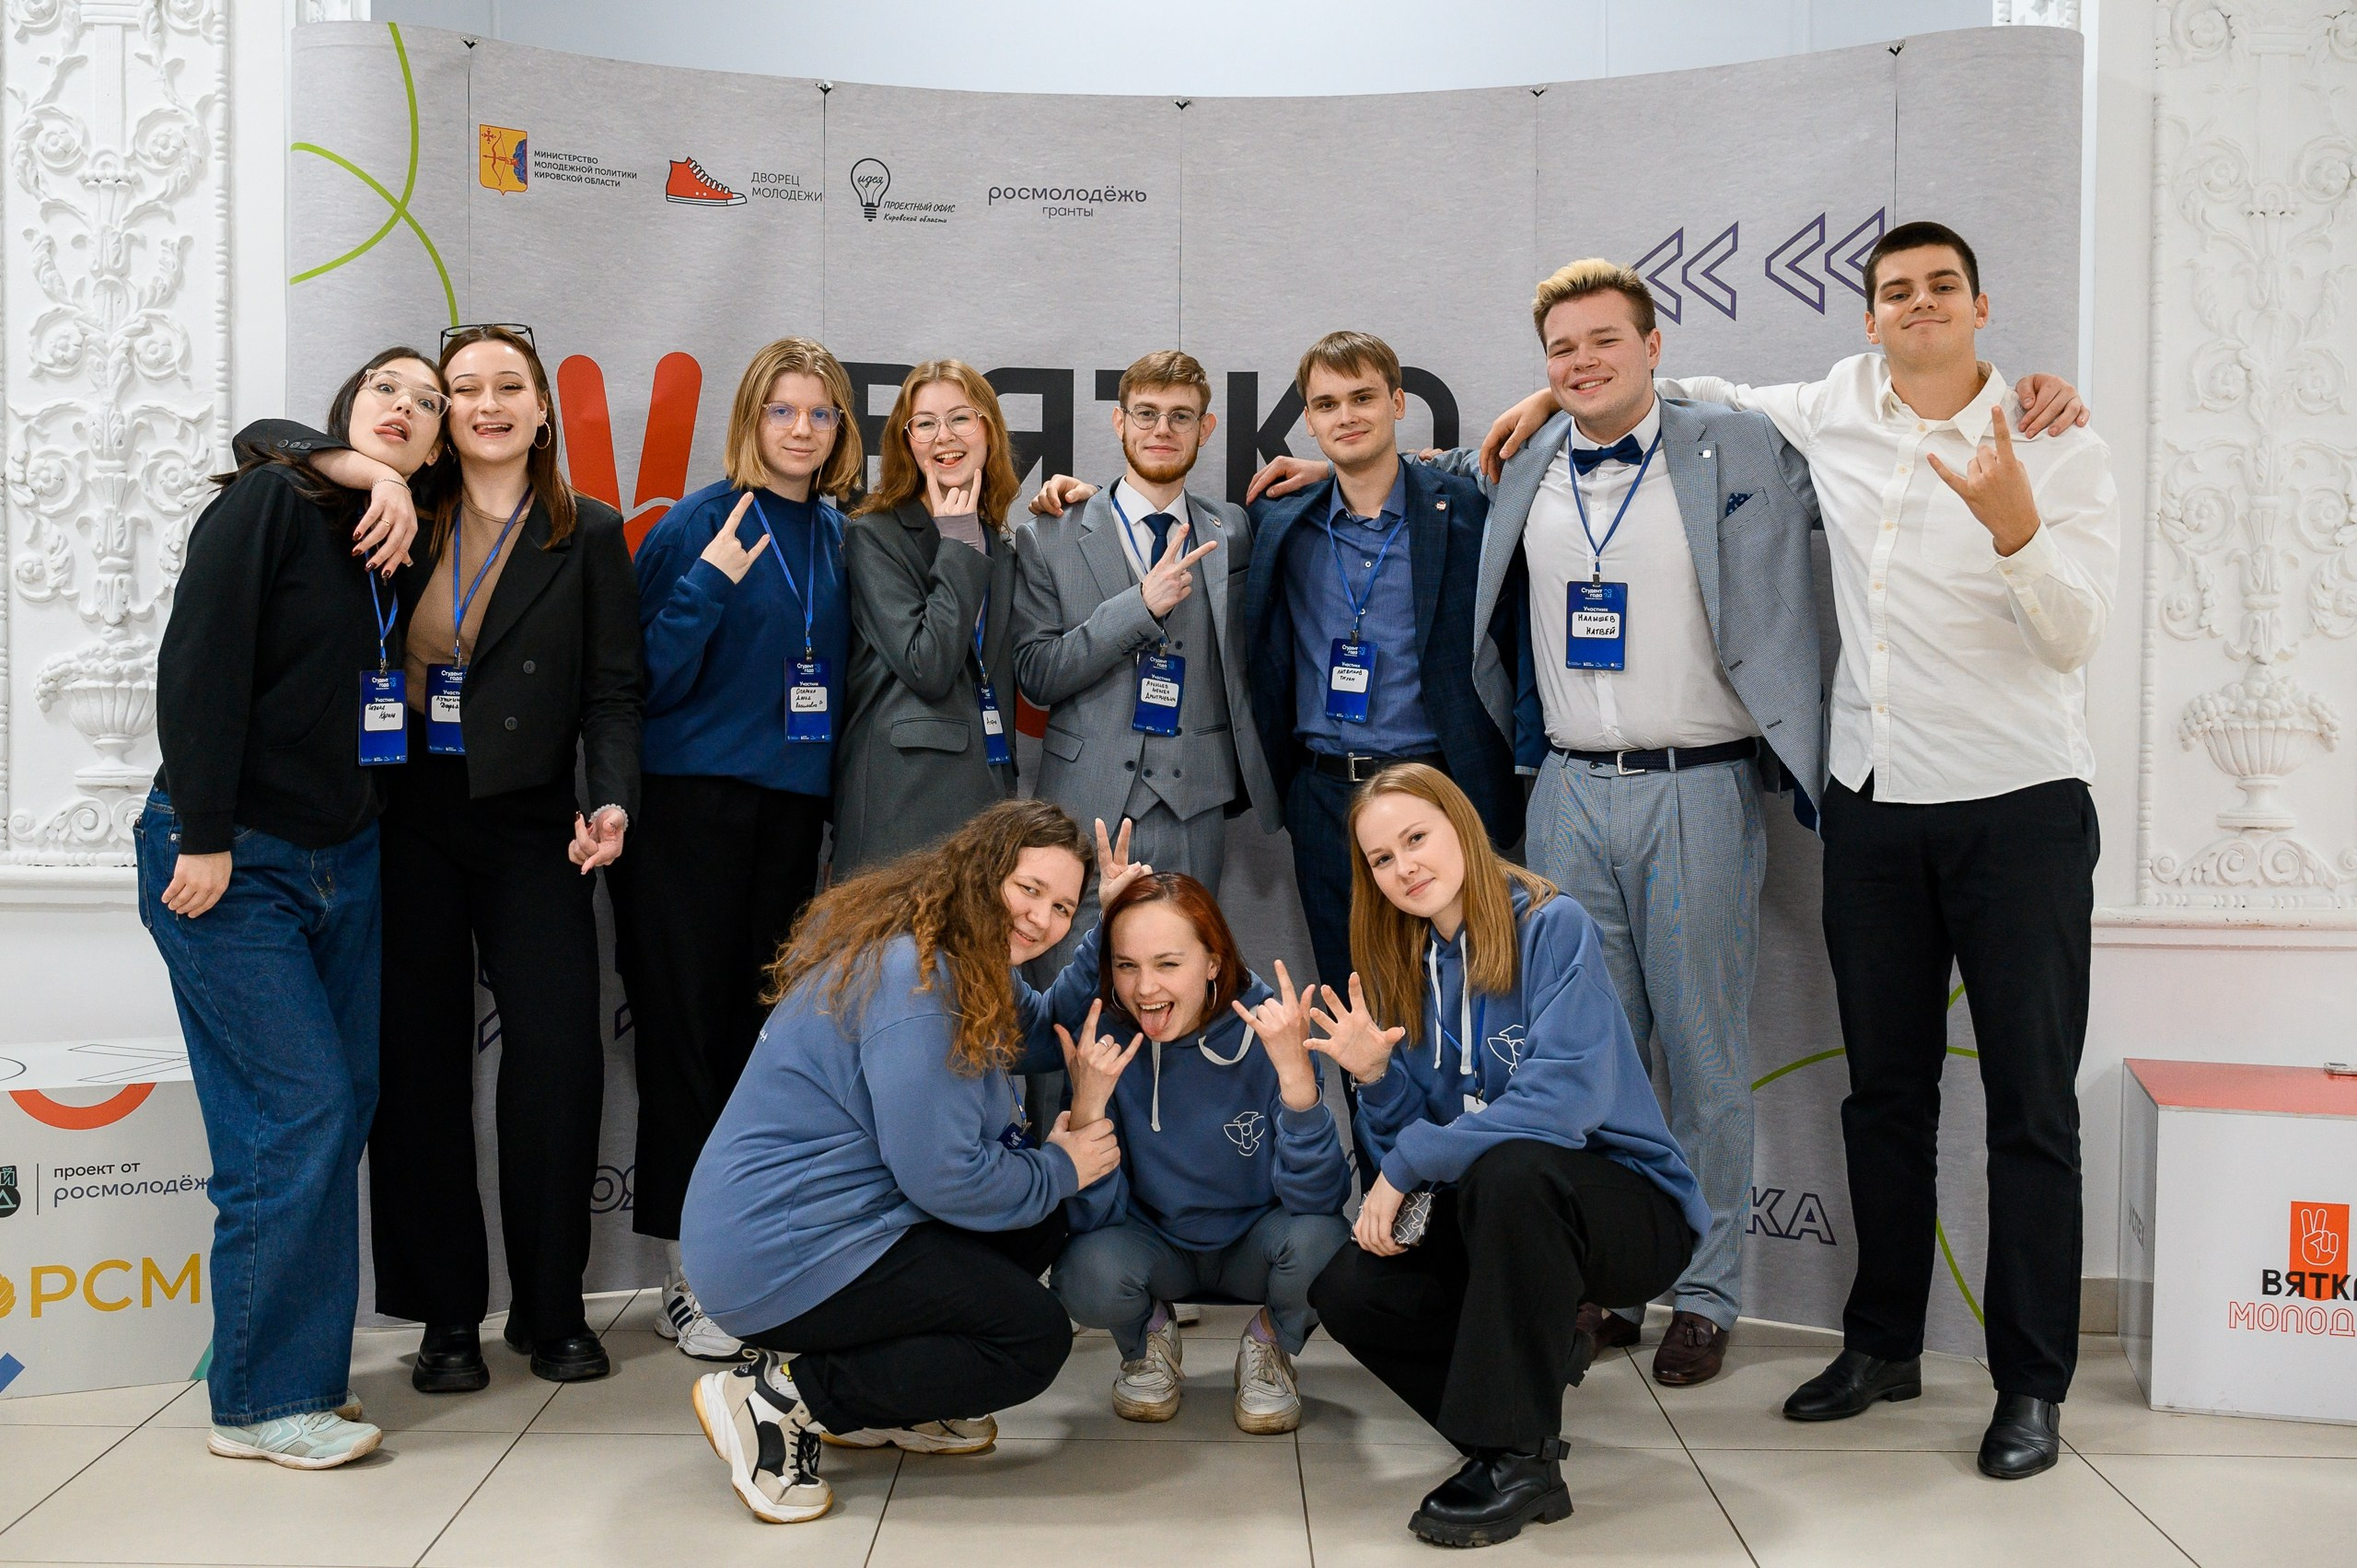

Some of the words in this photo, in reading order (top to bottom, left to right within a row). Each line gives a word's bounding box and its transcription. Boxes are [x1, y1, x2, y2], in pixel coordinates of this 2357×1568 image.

[534, 150, 598, 164] МИНИСТЕРСТВО
[534, 160, 593, 174] МОЛОДЕЖНОЙ
[595, 168, 637, 180] ПОЛИТИКИ
[534, 171, 583, 182] КИРОВСКОЙ
[584, 177, 621, 187] ОБЛАСТИ
[751, 172, 800, 187] ДВОРЕЦ
[857, 175, 884, 189] идея
[752, 187, 822, 202] МОЛОДЕЖИ
[988, 185, 1147, 205] росмолодёжь
[884, 201, 932, 212] ПРОЕКТНЫЙ
[933, 203, 956, 214] ОФИС
[1042, 206, 1094, 219] гранты
[884, 213, 917, 223] Кировской
[919, 215, 947, 223] области
[54, 1165, 115, 1180] проект
[121, 1162, 140, 1174] от
[54, 1175, 208, 1208] росмолодёж
[30, 1253, 201, 1318] РСМ
[2261, 1269, 2357, 1302] ВЯТК
[2229, 1301, 2356, 1337] МОЛОД
